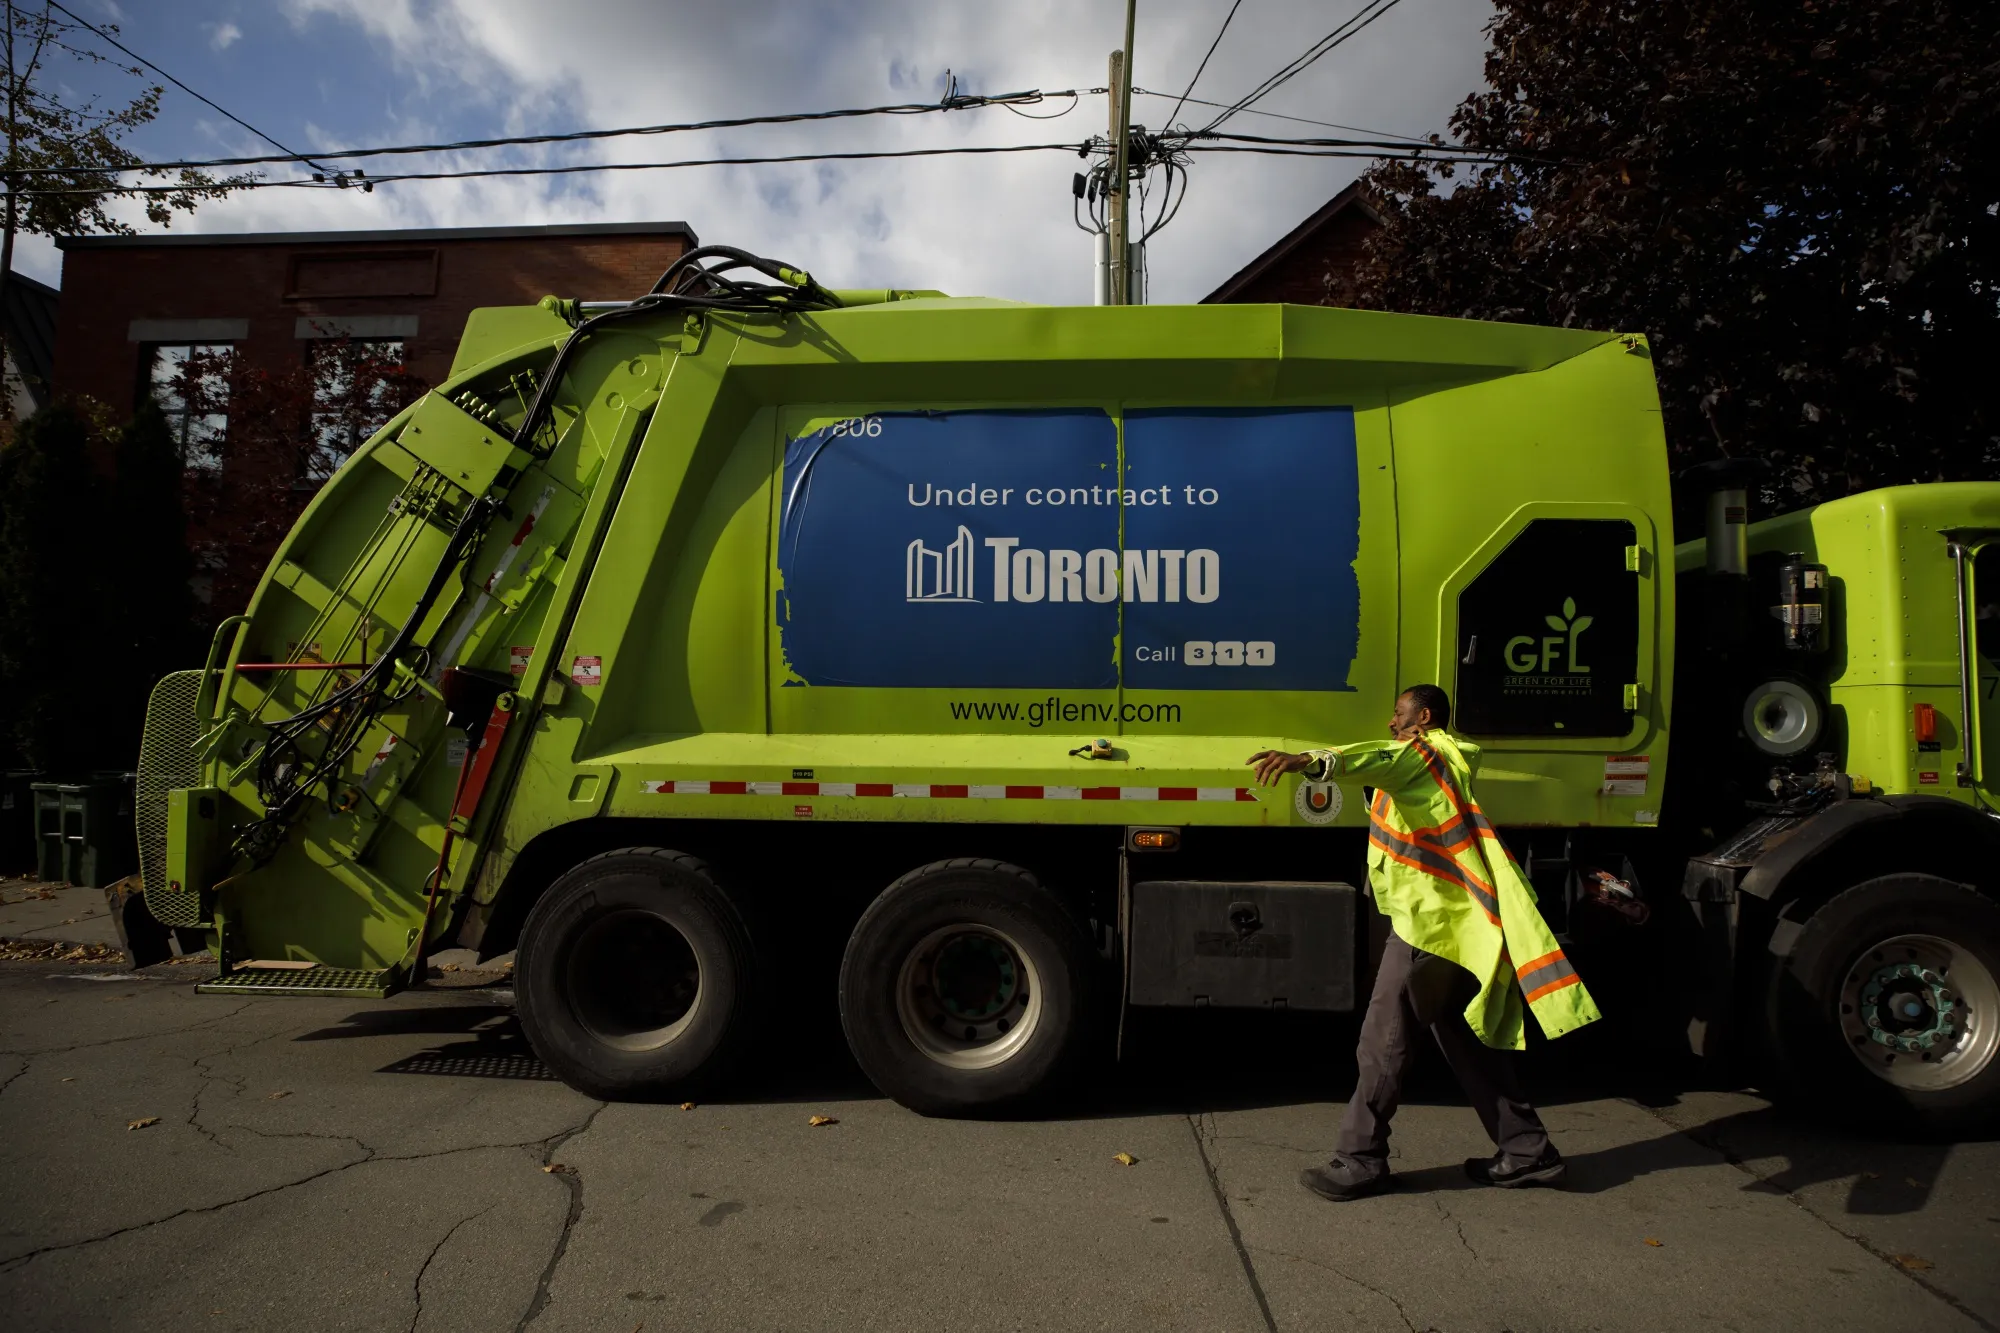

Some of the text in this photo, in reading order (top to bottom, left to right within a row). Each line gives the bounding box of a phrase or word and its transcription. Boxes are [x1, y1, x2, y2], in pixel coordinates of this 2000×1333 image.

[908, 482, 1219, 507] Under contract to
[1135, 645, 1175, 662] Call
[1503, 616, 1593, 674] GFL
[1503, 677, 1592, 686] GREEN FOR LIFE
[950, 698, 1181, 725] www.gflenv.com
